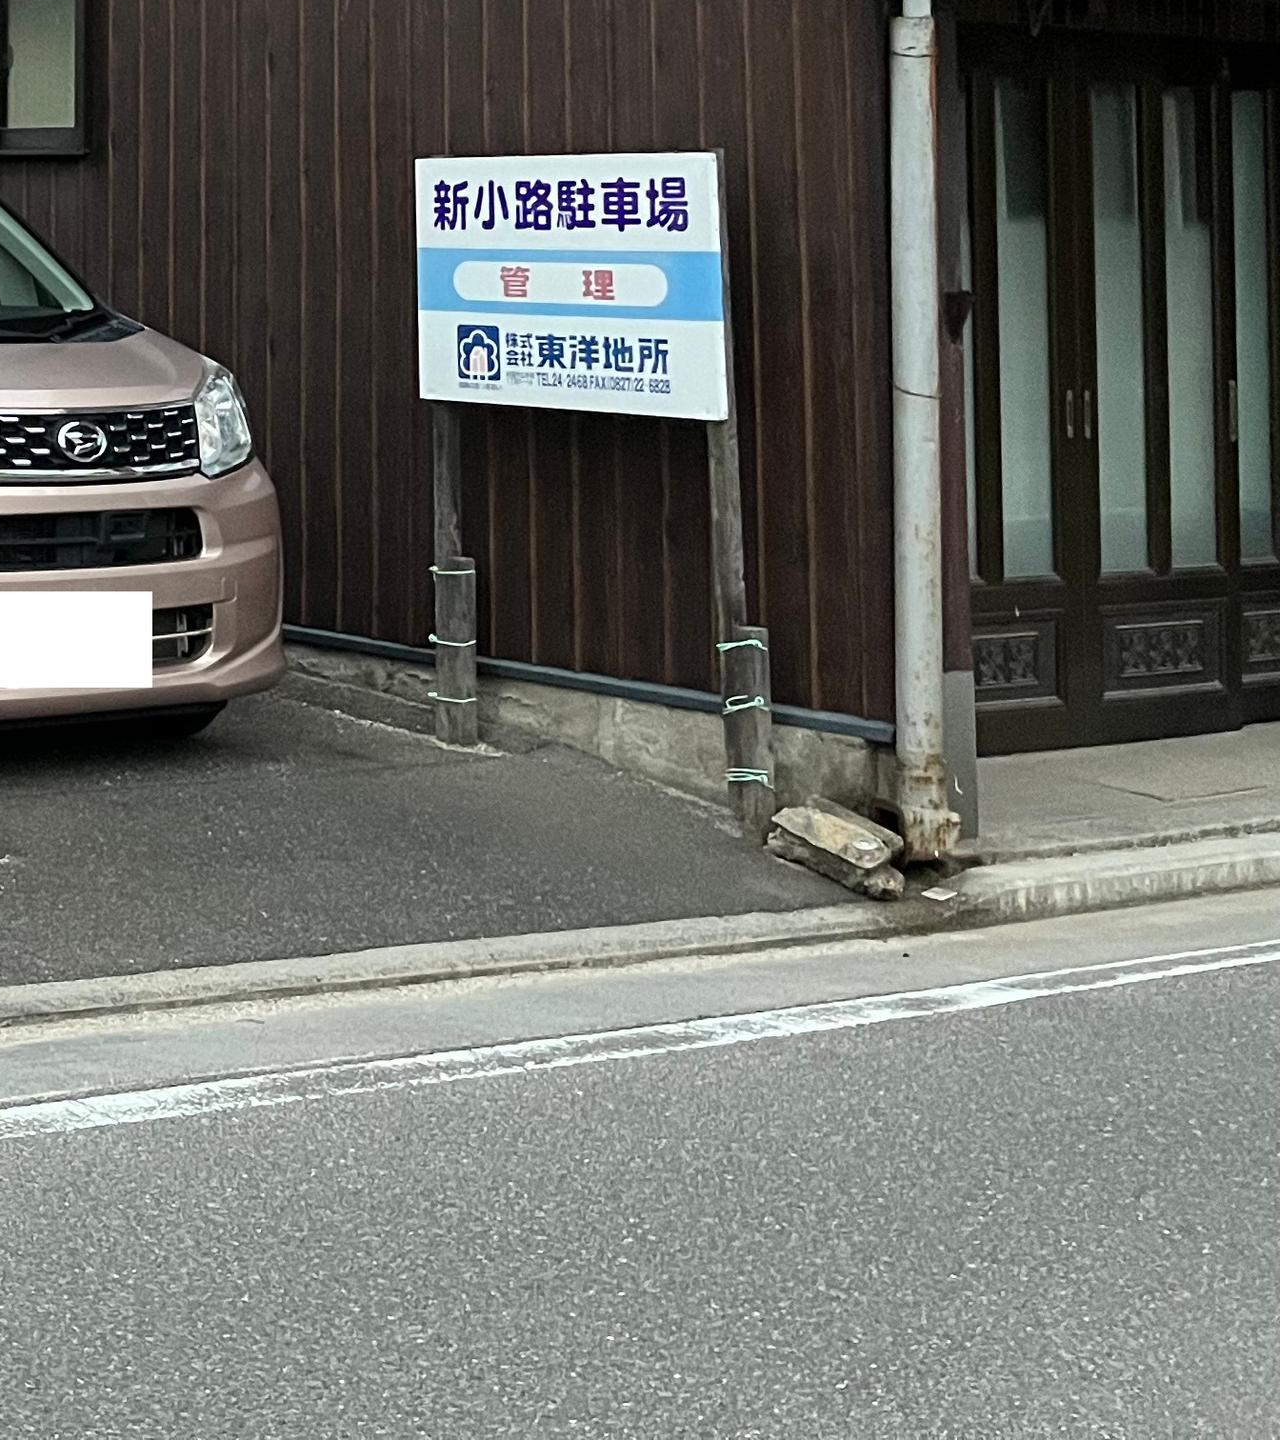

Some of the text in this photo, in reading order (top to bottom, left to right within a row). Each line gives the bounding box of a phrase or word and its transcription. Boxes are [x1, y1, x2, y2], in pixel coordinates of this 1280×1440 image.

[433, 177, 689, 233] 新小路駐車場
